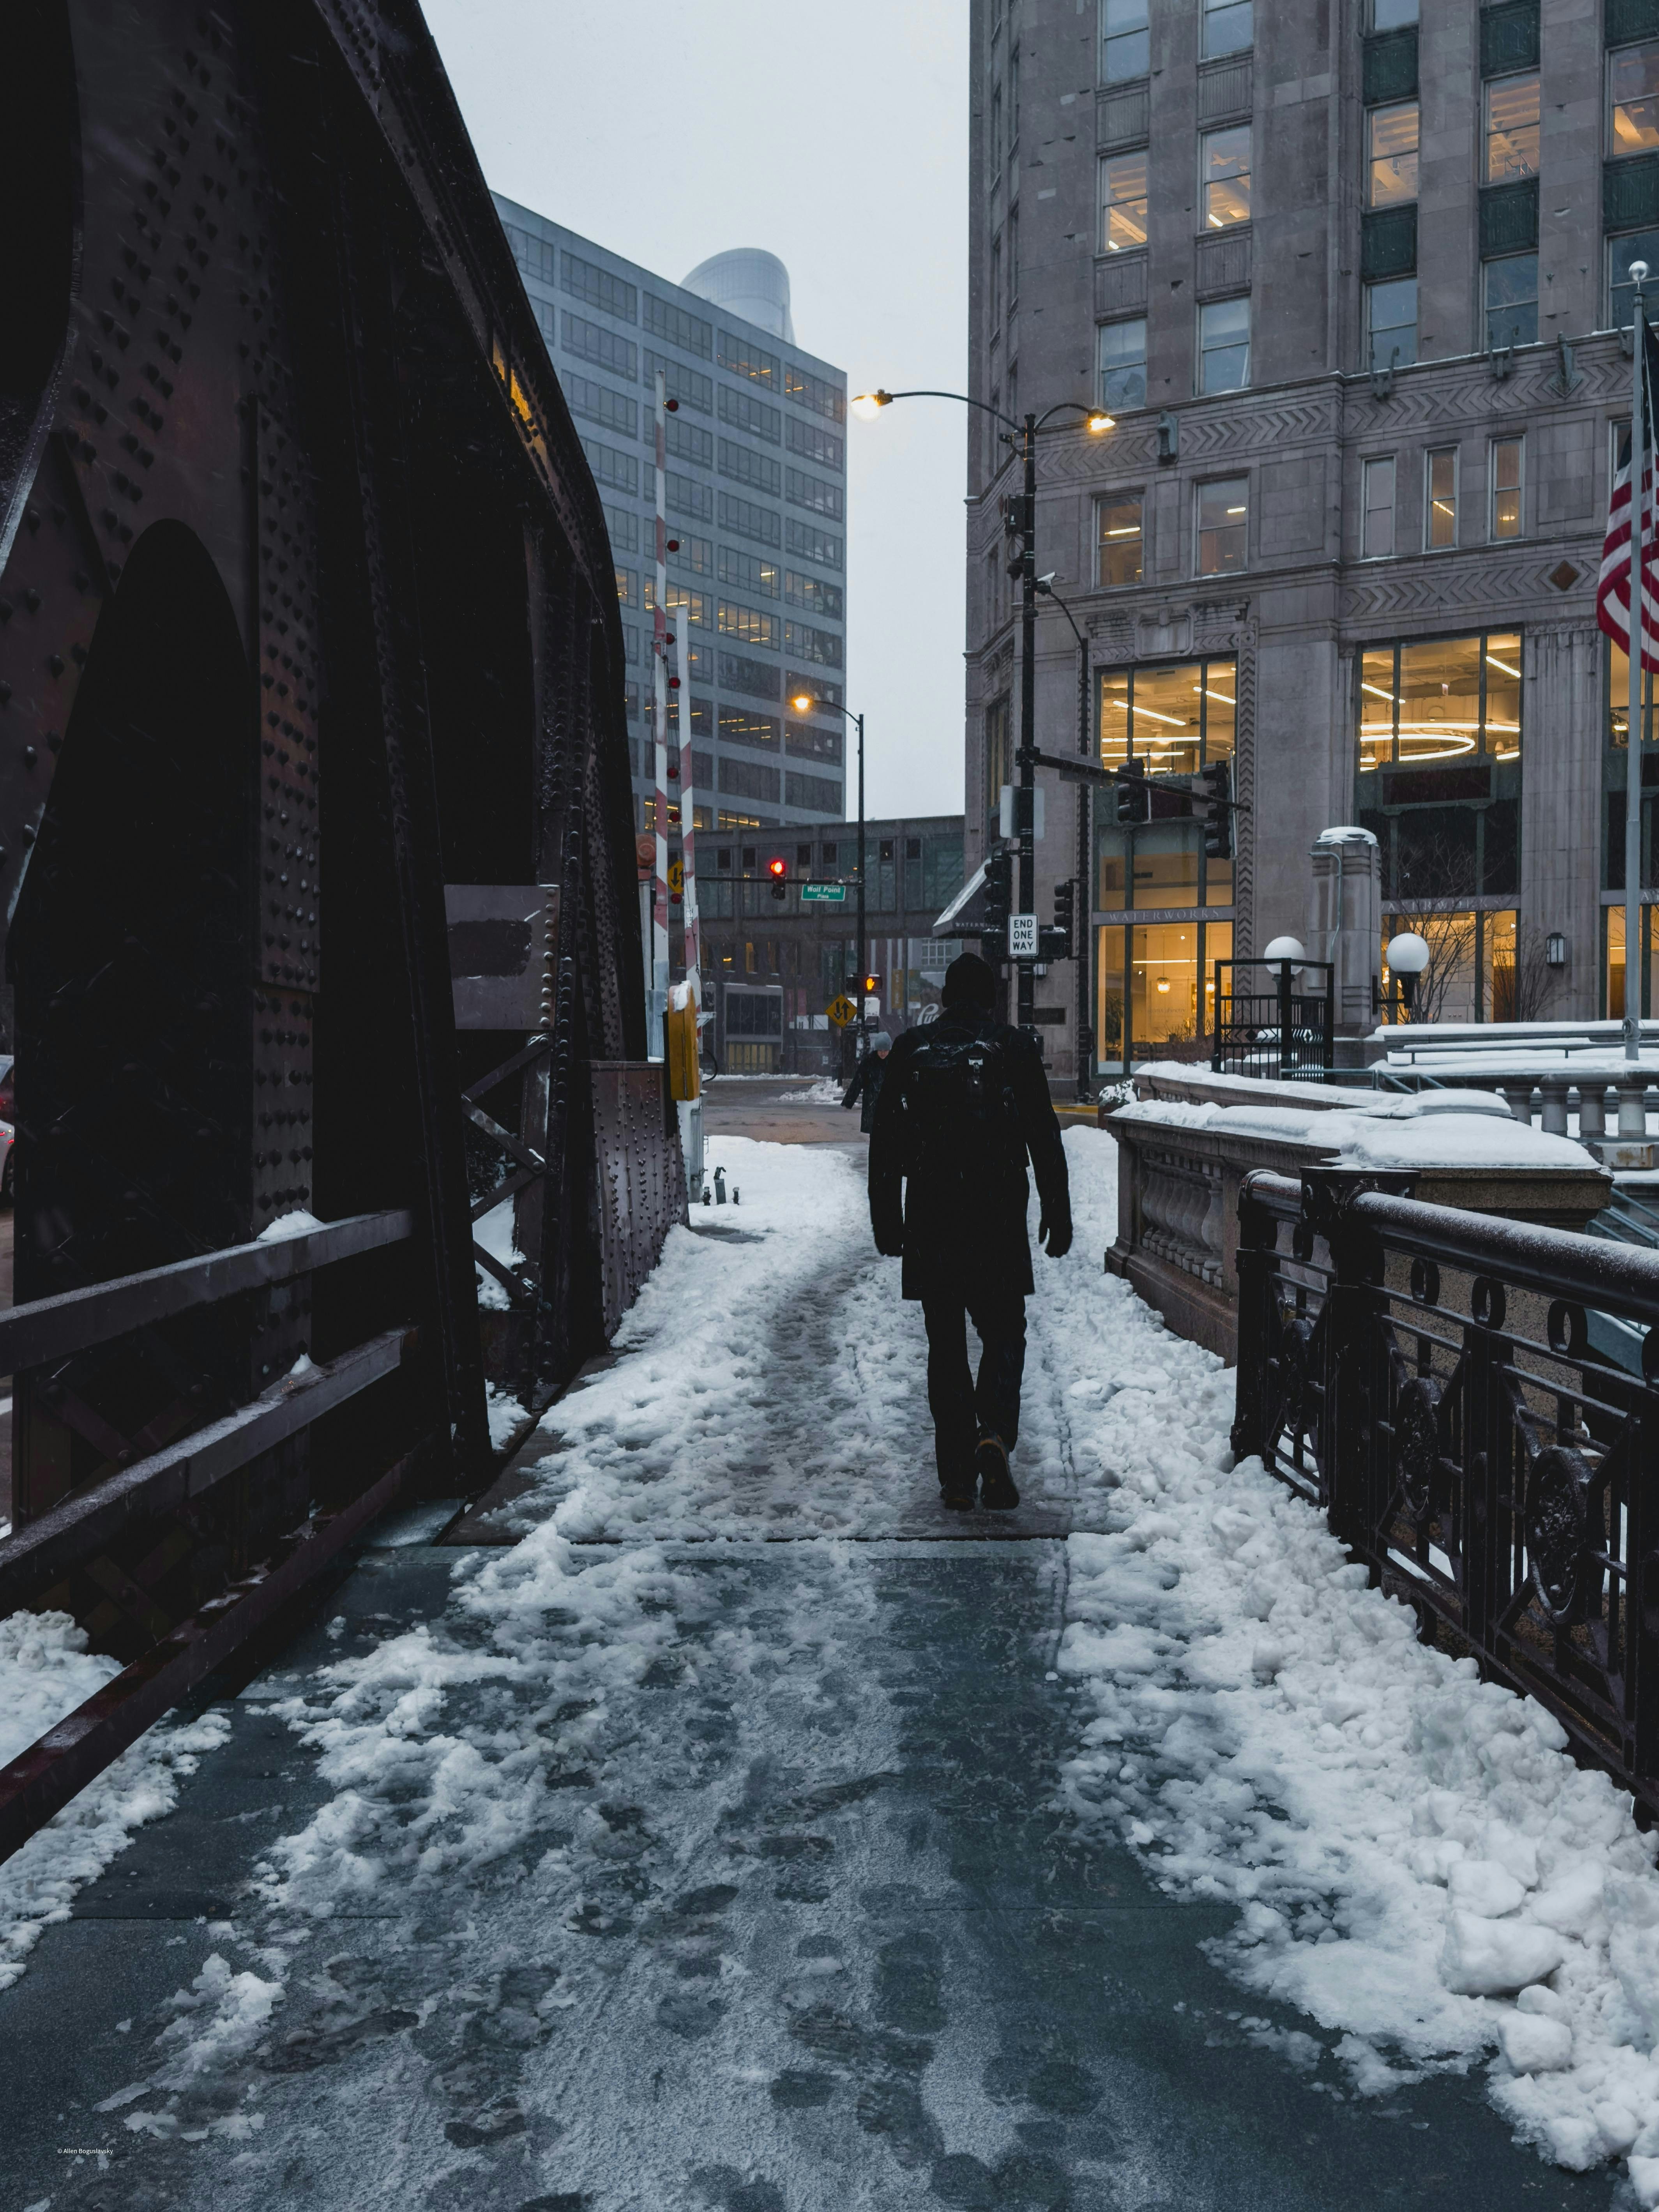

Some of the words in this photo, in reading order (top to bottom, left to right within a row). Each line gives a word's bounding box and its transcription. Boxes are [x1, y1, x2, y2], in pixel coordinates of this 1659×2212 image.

[1110, 909, 1219, 922] WATERWORKS
[1014, 920, 1033, 928] END
[1014, 931, 1033, 939] ONE
[1013, 942, 1033, 950] WAY
